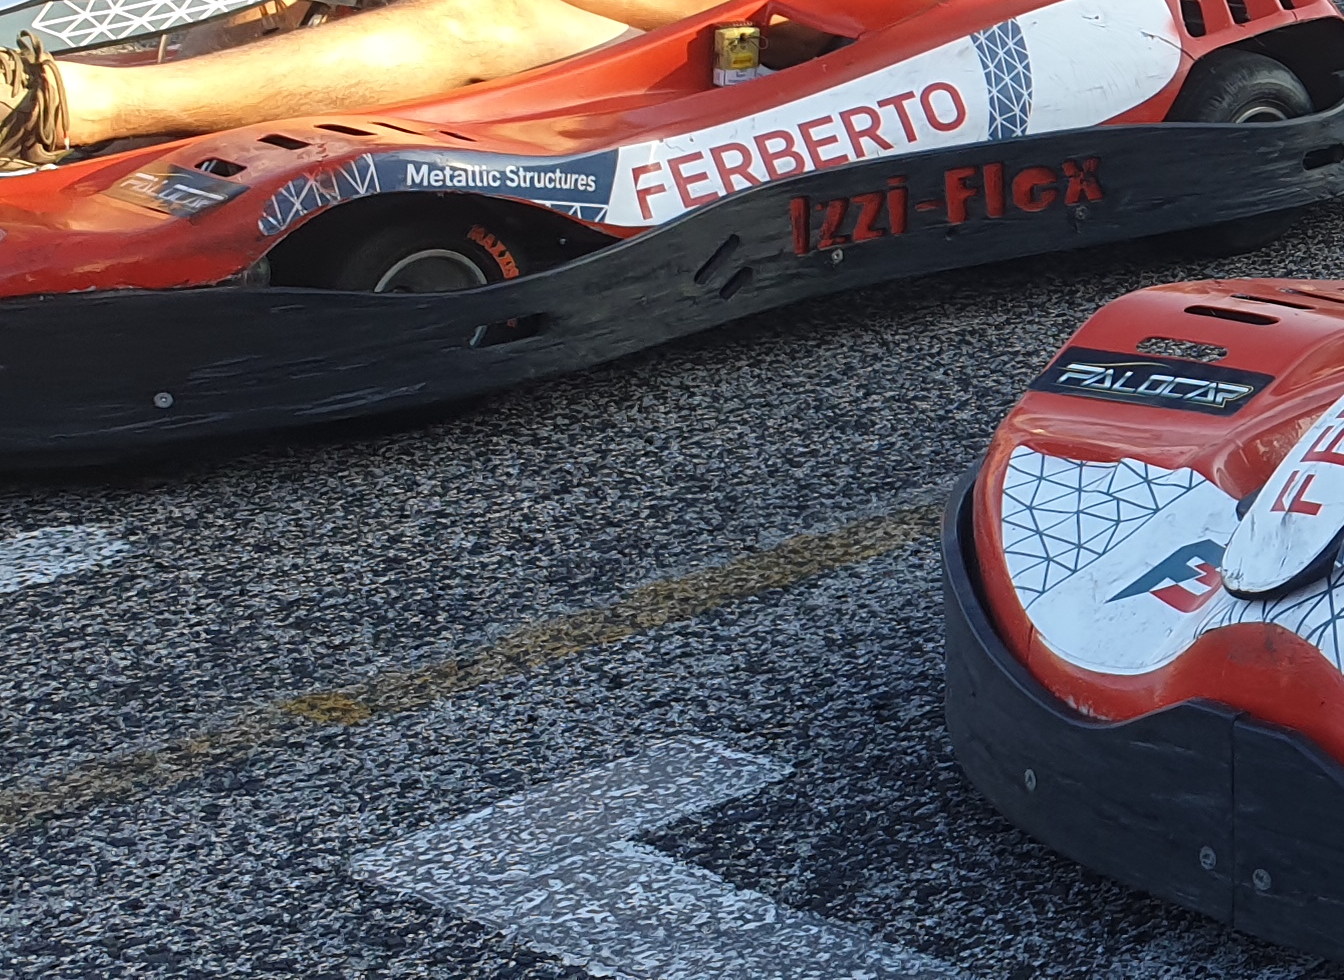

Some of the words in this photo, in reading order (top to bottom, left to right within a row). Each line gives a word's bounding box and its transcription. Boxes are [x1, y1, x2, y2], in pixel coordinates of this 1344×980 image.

[631, 81, 967, 220] FERBERTO
[406, 163, 501, 188] Metallic
[505, 166, 597, 192] Structures
[1056, 363, 1253, 406] PALOCAR
